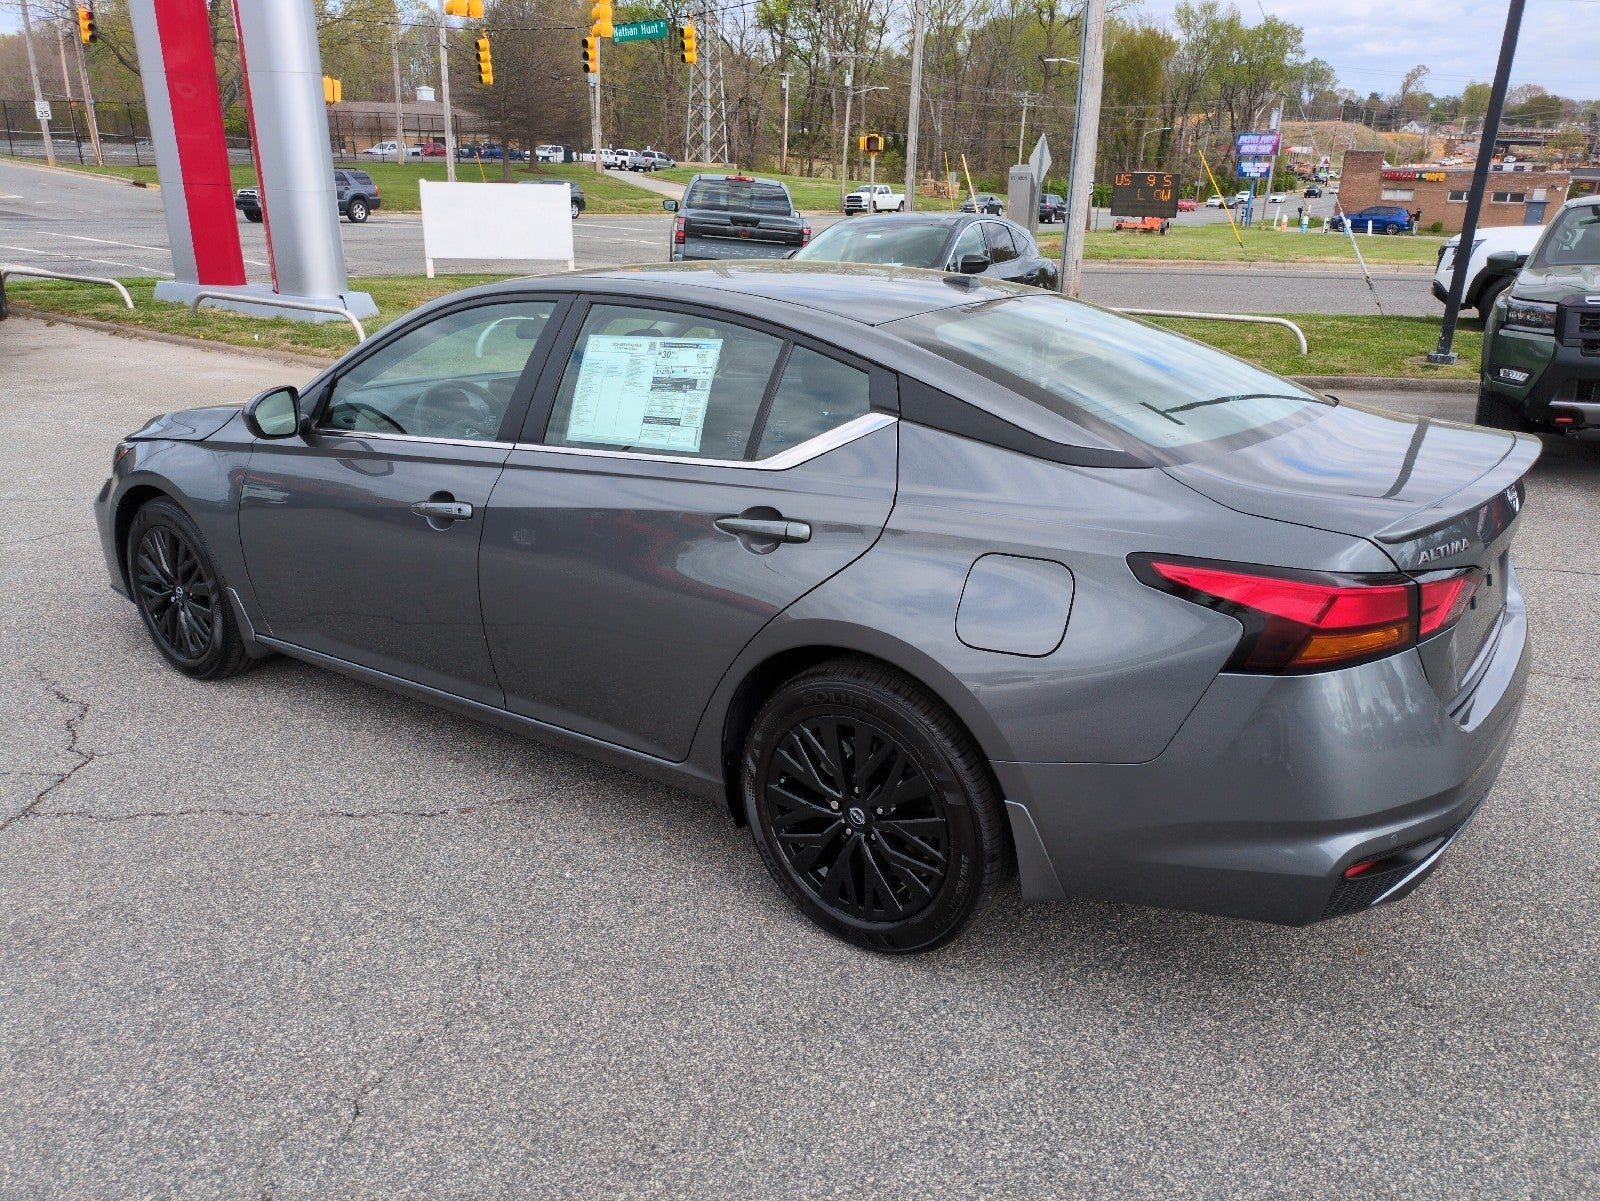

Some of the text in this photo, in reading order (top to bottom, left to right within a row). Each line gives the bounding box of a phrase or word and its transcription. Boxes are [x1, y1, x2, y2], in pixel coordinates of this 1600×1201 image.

[613, 26, 638, 37] Nathan
[640, 23, 659, 35] Hunt
[38, 110, 50, 118] 35
[1115, 173, 1132, 186] US
[1425, 172, 1445, 182] VAPE
[1419, 538, 1470, 565] ALTIMA
